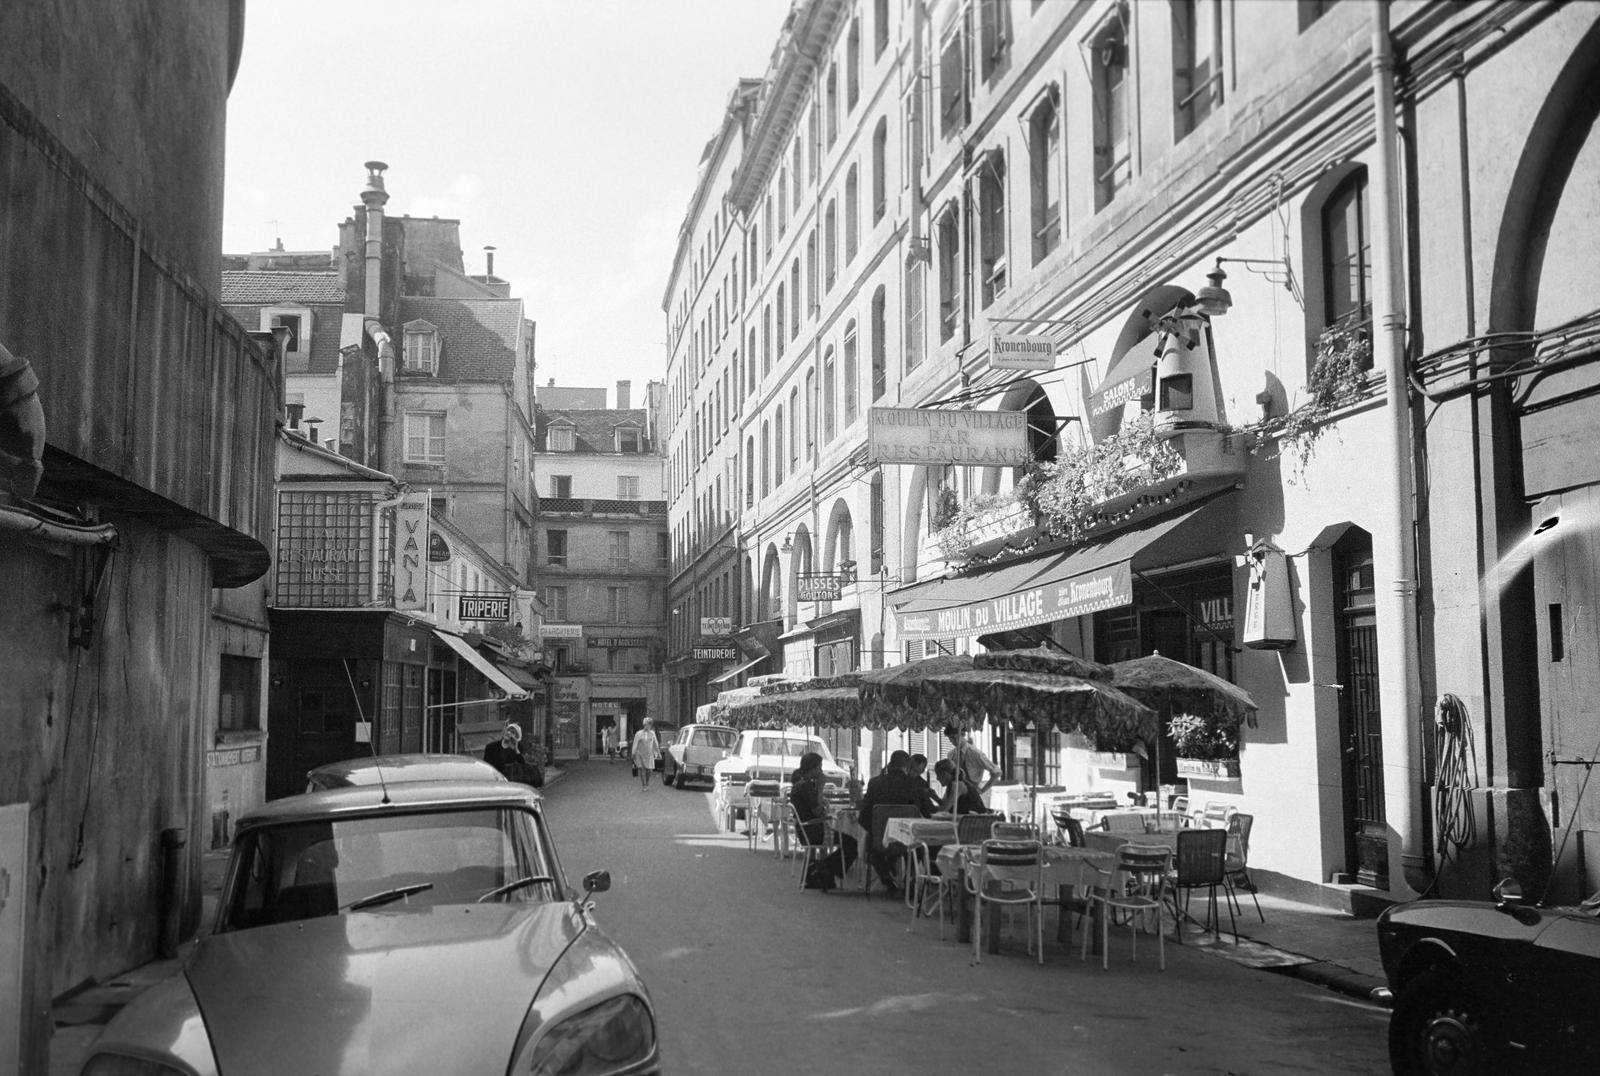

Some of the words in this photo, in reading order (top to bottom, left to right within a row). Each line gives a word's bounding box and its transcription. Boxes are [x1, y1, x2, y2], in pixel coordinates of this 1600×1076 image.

[993, 337, 1052, 356] Kronenbourg
[1103, 377, 1136, 401] SALONS
[873, 411, 931, 427] MOULIN
[938, 413, 957, 428] DU
[963, 413, 1023, 430] VILLAGE
[929, 429, 970, 446] BAR
[876, 443, 1025, 463] RESTAURANT
[402, 519, 420, 602] VANIA
[1070, 575, 1114, 604] Kronenbourg
[461, 600, 509, 618] TRIPERIE
[938, 607, 971, 632] MOULIN
[976, 607, 989, 627] DU
[994, 590, 1043, 623] VILLAGE
[692, 648, 737, 660] TEINTURERIE
